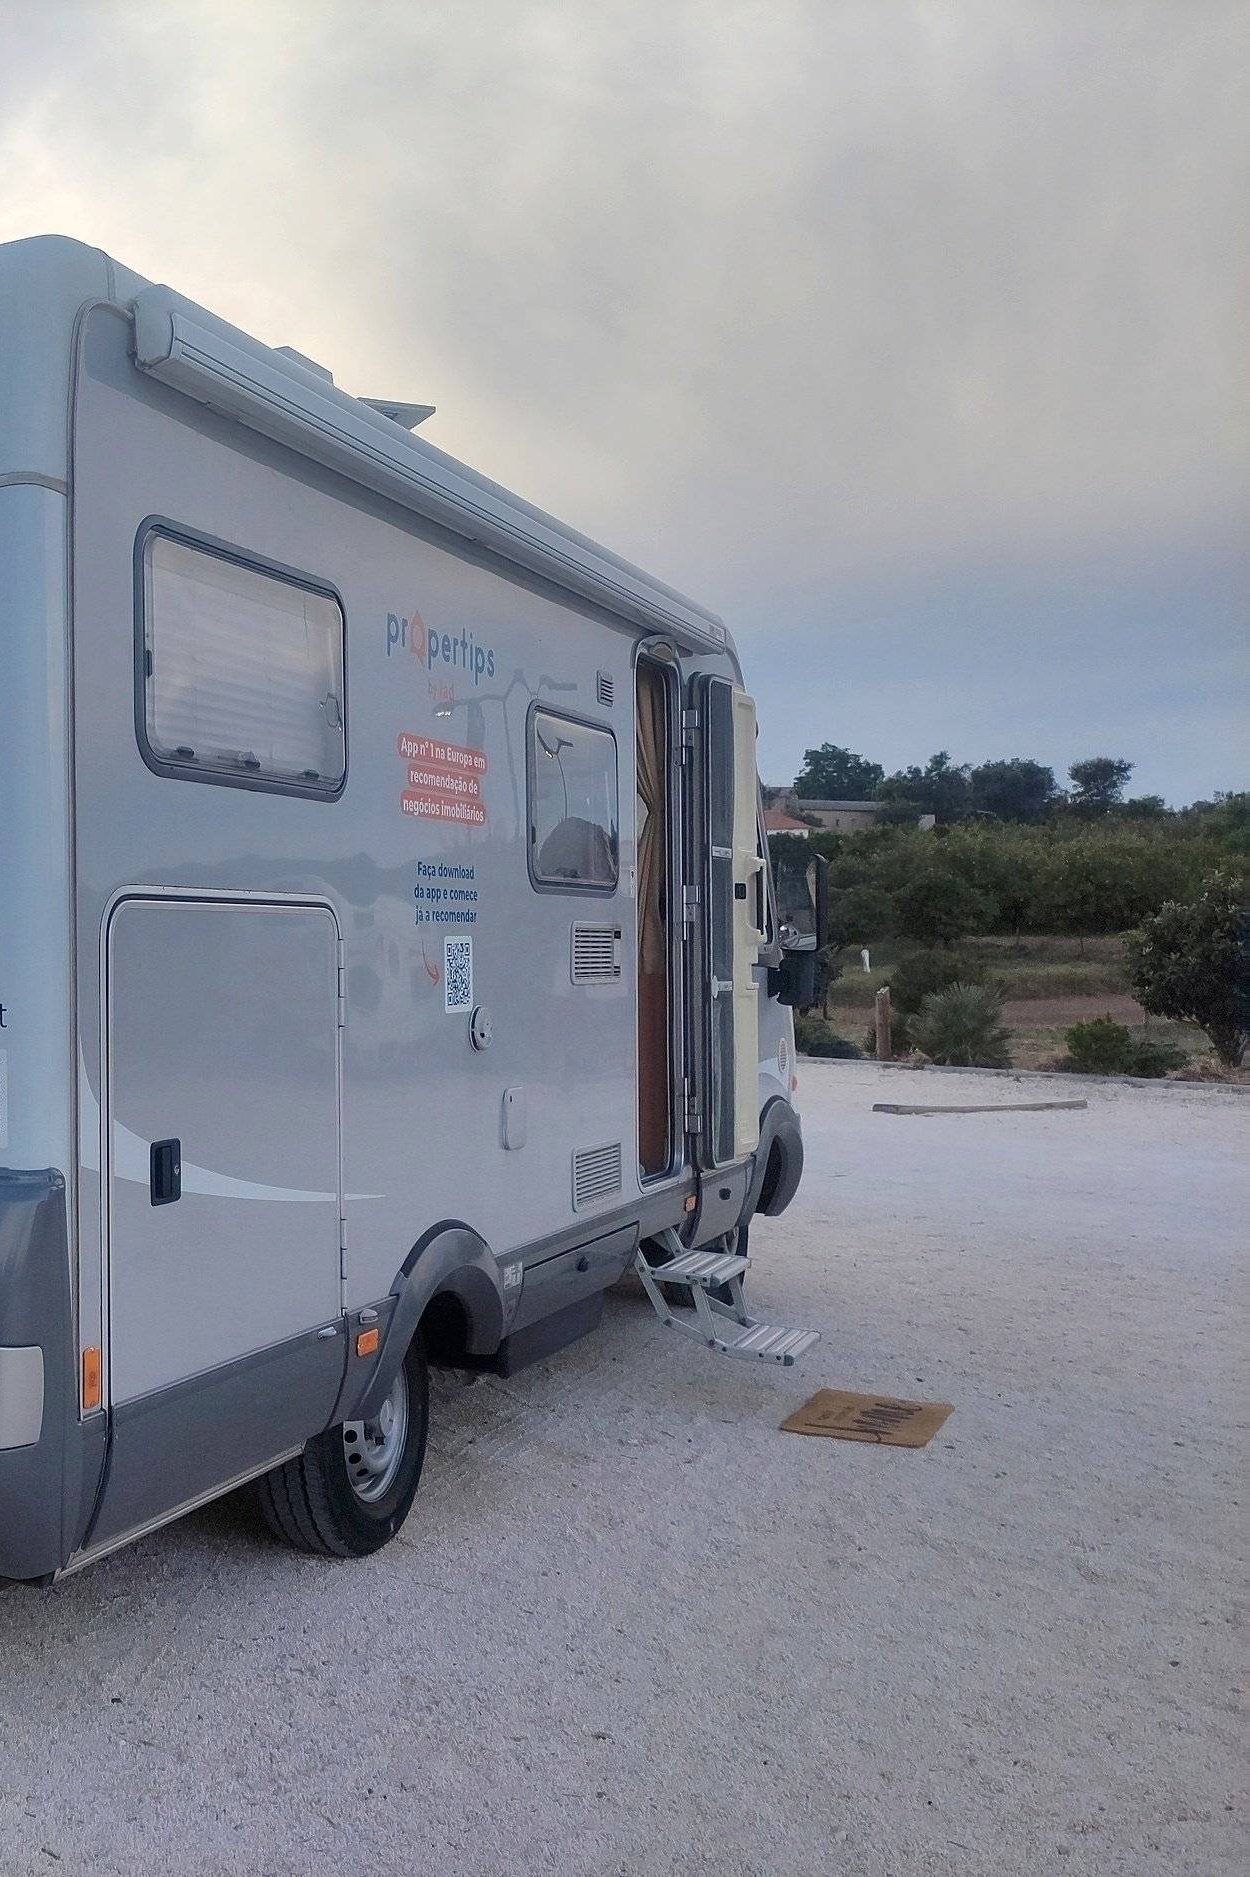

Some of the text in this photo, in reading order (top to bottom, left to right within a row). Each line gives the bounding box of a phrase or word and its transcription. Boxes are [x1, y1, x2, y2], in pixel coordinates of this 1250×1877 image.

[386, 610, 495, 686] propertips
[400, 737, 419, 758] App
[429, 742, 435, 758] 1
[435, 747, 445, 760] na
[446, 747, 473, 768] Europa
[473, 755, 486, 769] em
[410, 770, 479, 795] recomendação de
[403, 797, 485, 822] negócios imobiliários
[417, 861, 476, 880] Faça download
[414, 883, 479, 903] da app e comece
[415, 904, 478, 926] já a recomendar
